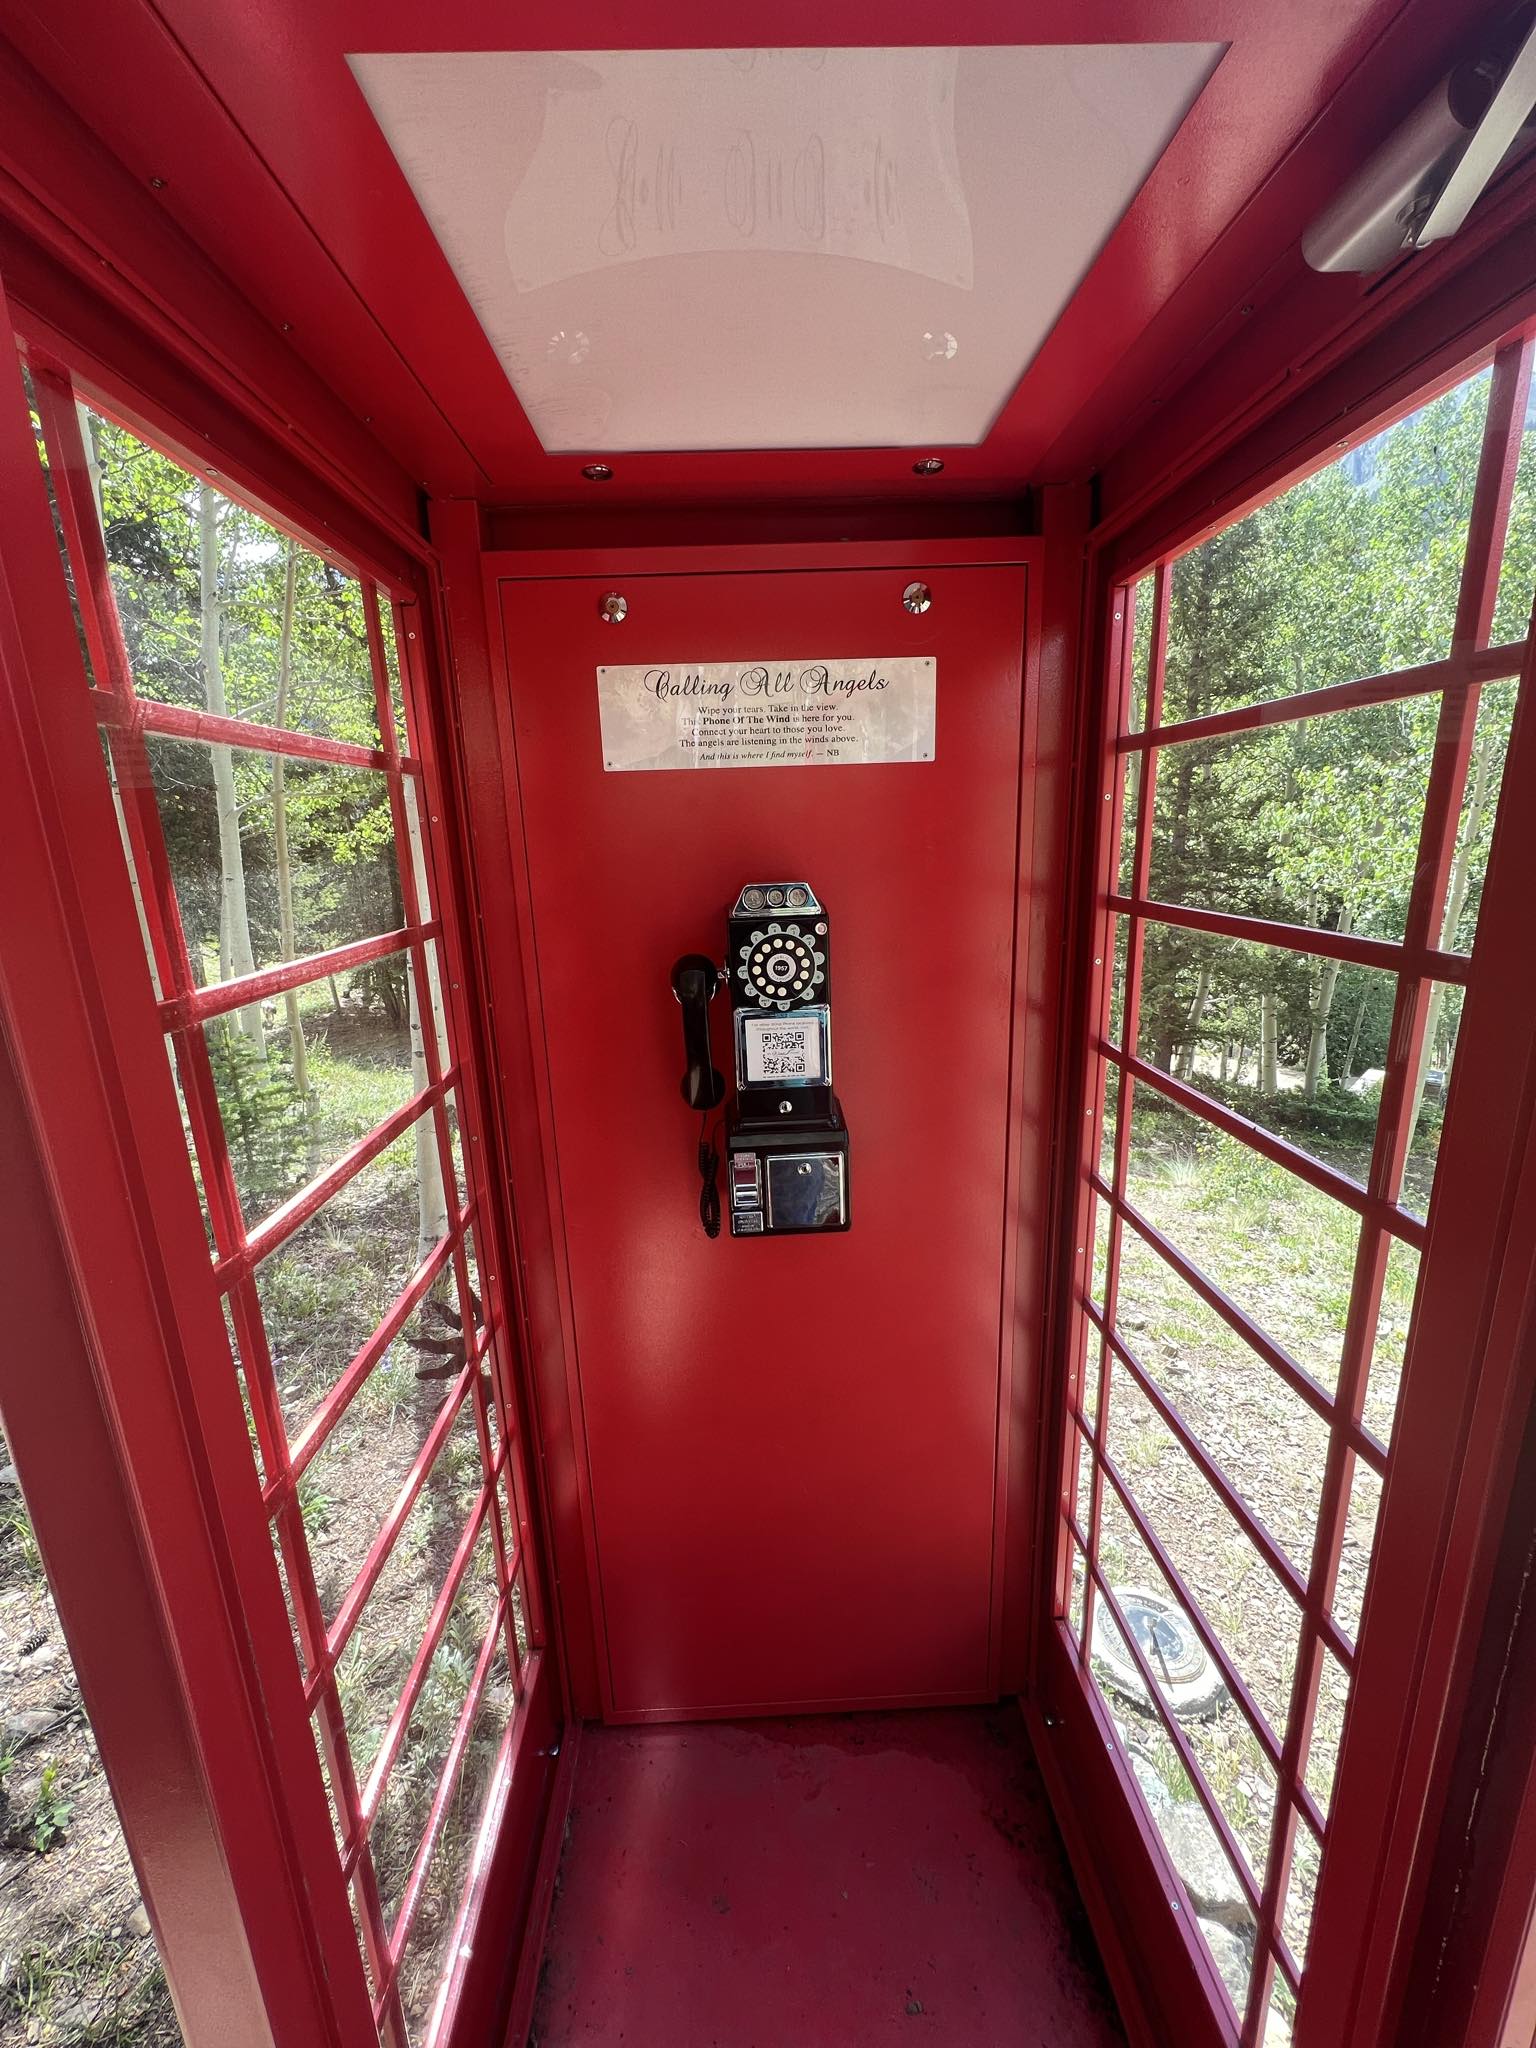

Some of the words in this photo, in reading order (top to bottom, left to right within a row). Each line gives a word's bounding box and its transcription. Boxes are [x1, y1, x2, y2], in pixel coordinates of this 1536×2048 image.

[644, 669, 734, 703] Calling
[740, 667, 795, 698] All
[800, 665, 890, 698] Angels
[698, 706, 720, 716] Wipe
[722, 707, 741, 716] your
[743, 706, 766, 714] tears.
[768, 704, 788, 713] Take
[790, 704, 799, 712] in
[801, 704, 814, 712] the
[816, 703, 839, 711] view.
[703, 717, 730, 725] Phone
[732, 716, 744, 724] Of
[746, 715, 764, 724] The
[766, 714, 790, 723] Wind
[802, 714, 820, 722] here
[822, 713, 834, 722] for
[836, 714, 855, 723] you.
[692, 728, 726, 736] Connect
[728, 728, 747, 737] your
[749, 726, 770, 734] heart
[783, 725, 805, 733] those
[807, 726, 823, 734] you
[825, 724, 846, 732] love.
[680, 739, 695, 747] The
[698, 739, 724, 748] angels
[741, 737, 777, 747] listening
[789, 736, 802, 744] the
[805, 735, 829, 743] winds
[831, 734, 859, 743] above.
[700, 752, 716, 760] And
[717, 752, 731, 760] this
[741, 751, 764, 759] where
[770, 751, 786, 760] find
[787, 750, 814, 759] myself.
[827, 749, 840, 757] NB
